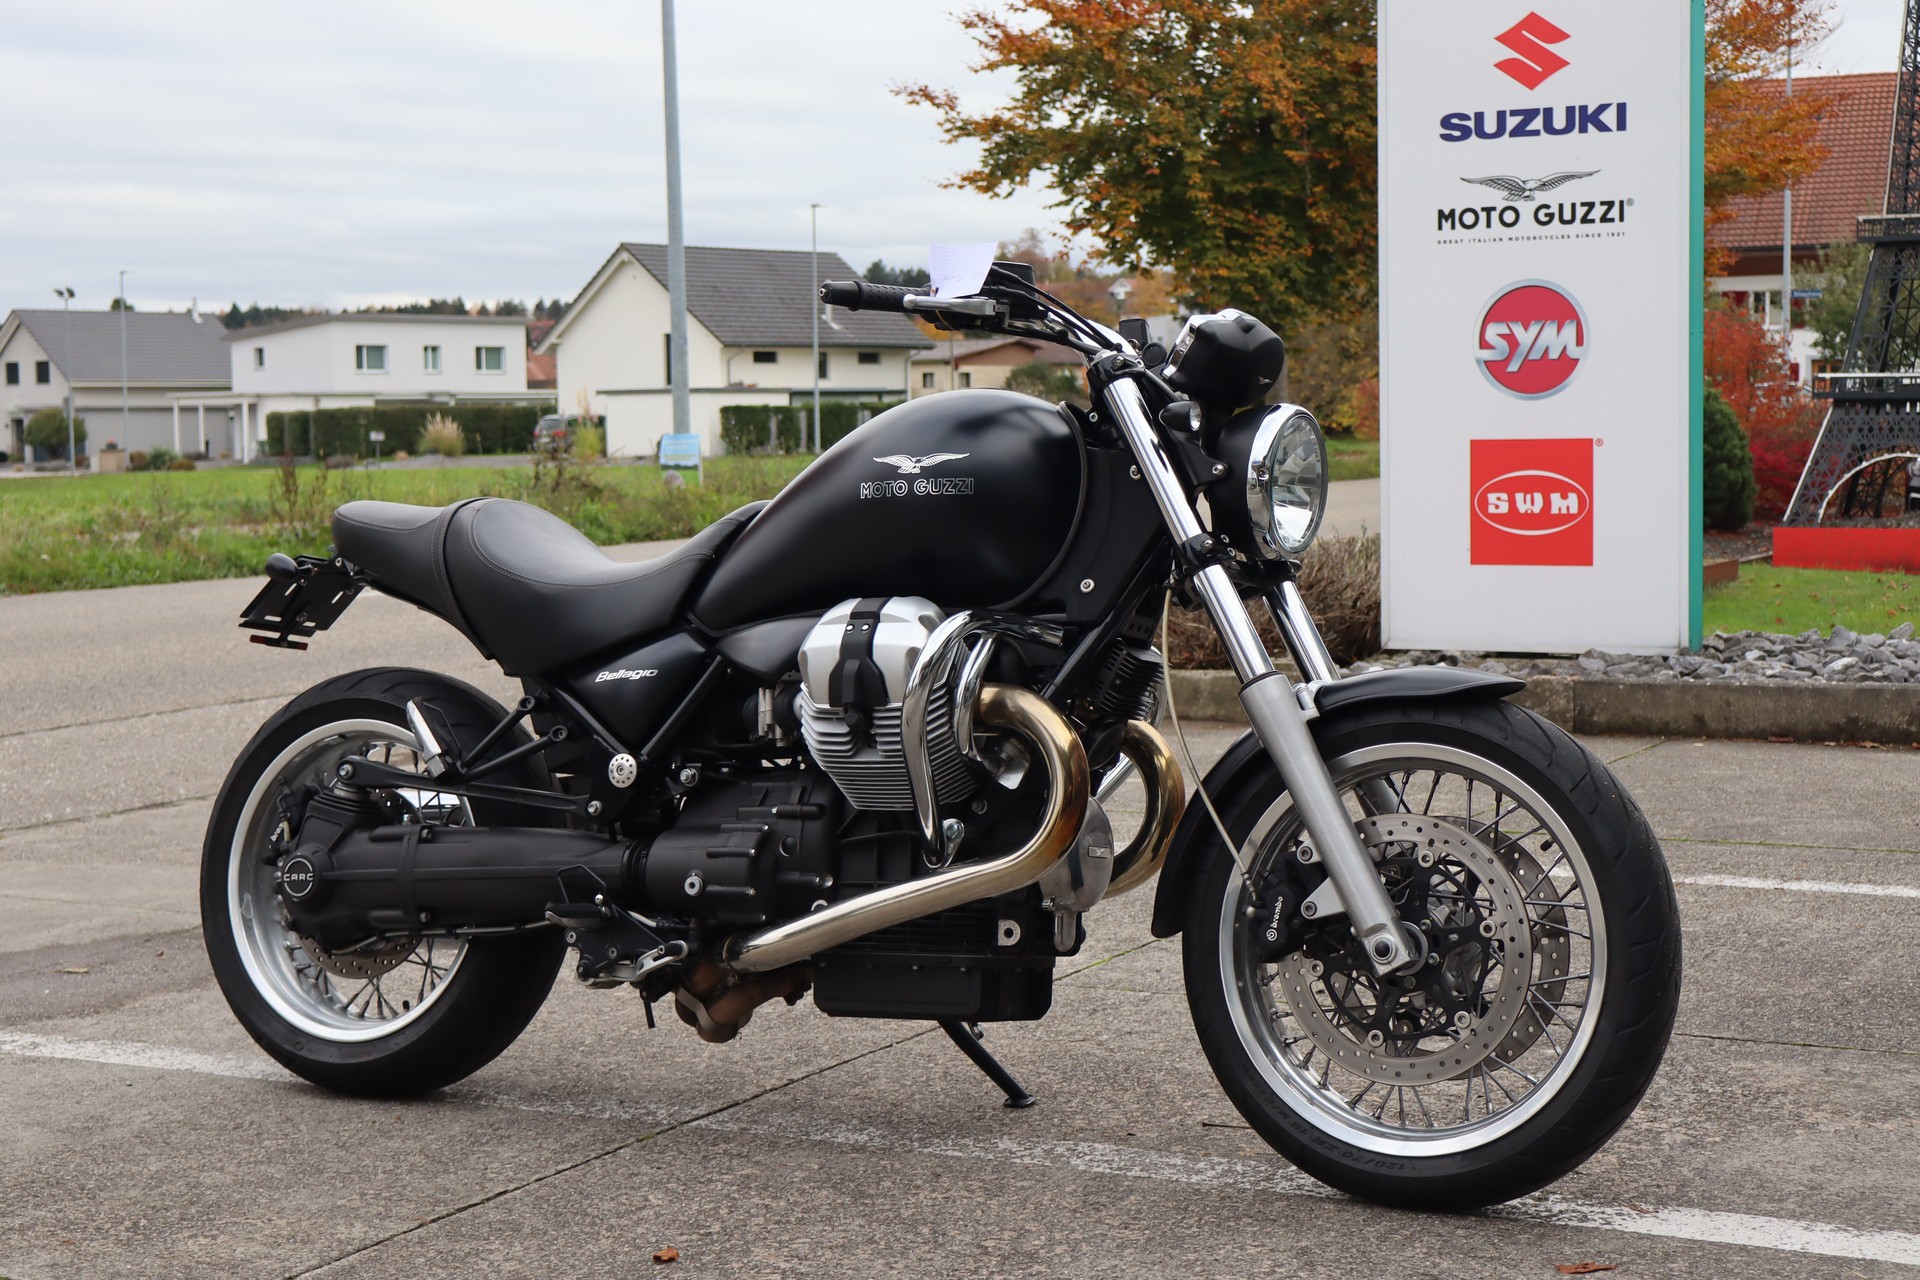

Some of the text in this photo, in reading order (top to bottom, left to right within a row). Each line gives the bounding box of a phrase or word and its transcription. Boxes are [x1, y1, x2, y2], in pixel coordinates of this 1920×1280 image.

[1439, 102, 1628, 142] SUZUKI
[1437, 205, 1520, 231] MOTO
[1468, 236, 1503, 244] ITALIAN
[1508, 233, 1571, 242] MOTORCYCLES
[1475, 319, 1584, 373] SYM
[860, 478, 975, 499] MOTO GUZZI
[1487, 492, 1579, 514] SWM
[595, 669, 659, 683] Bellagio
[283, 873, 314, 881] CARC
[1270, 896, 1283, 929] brembo
